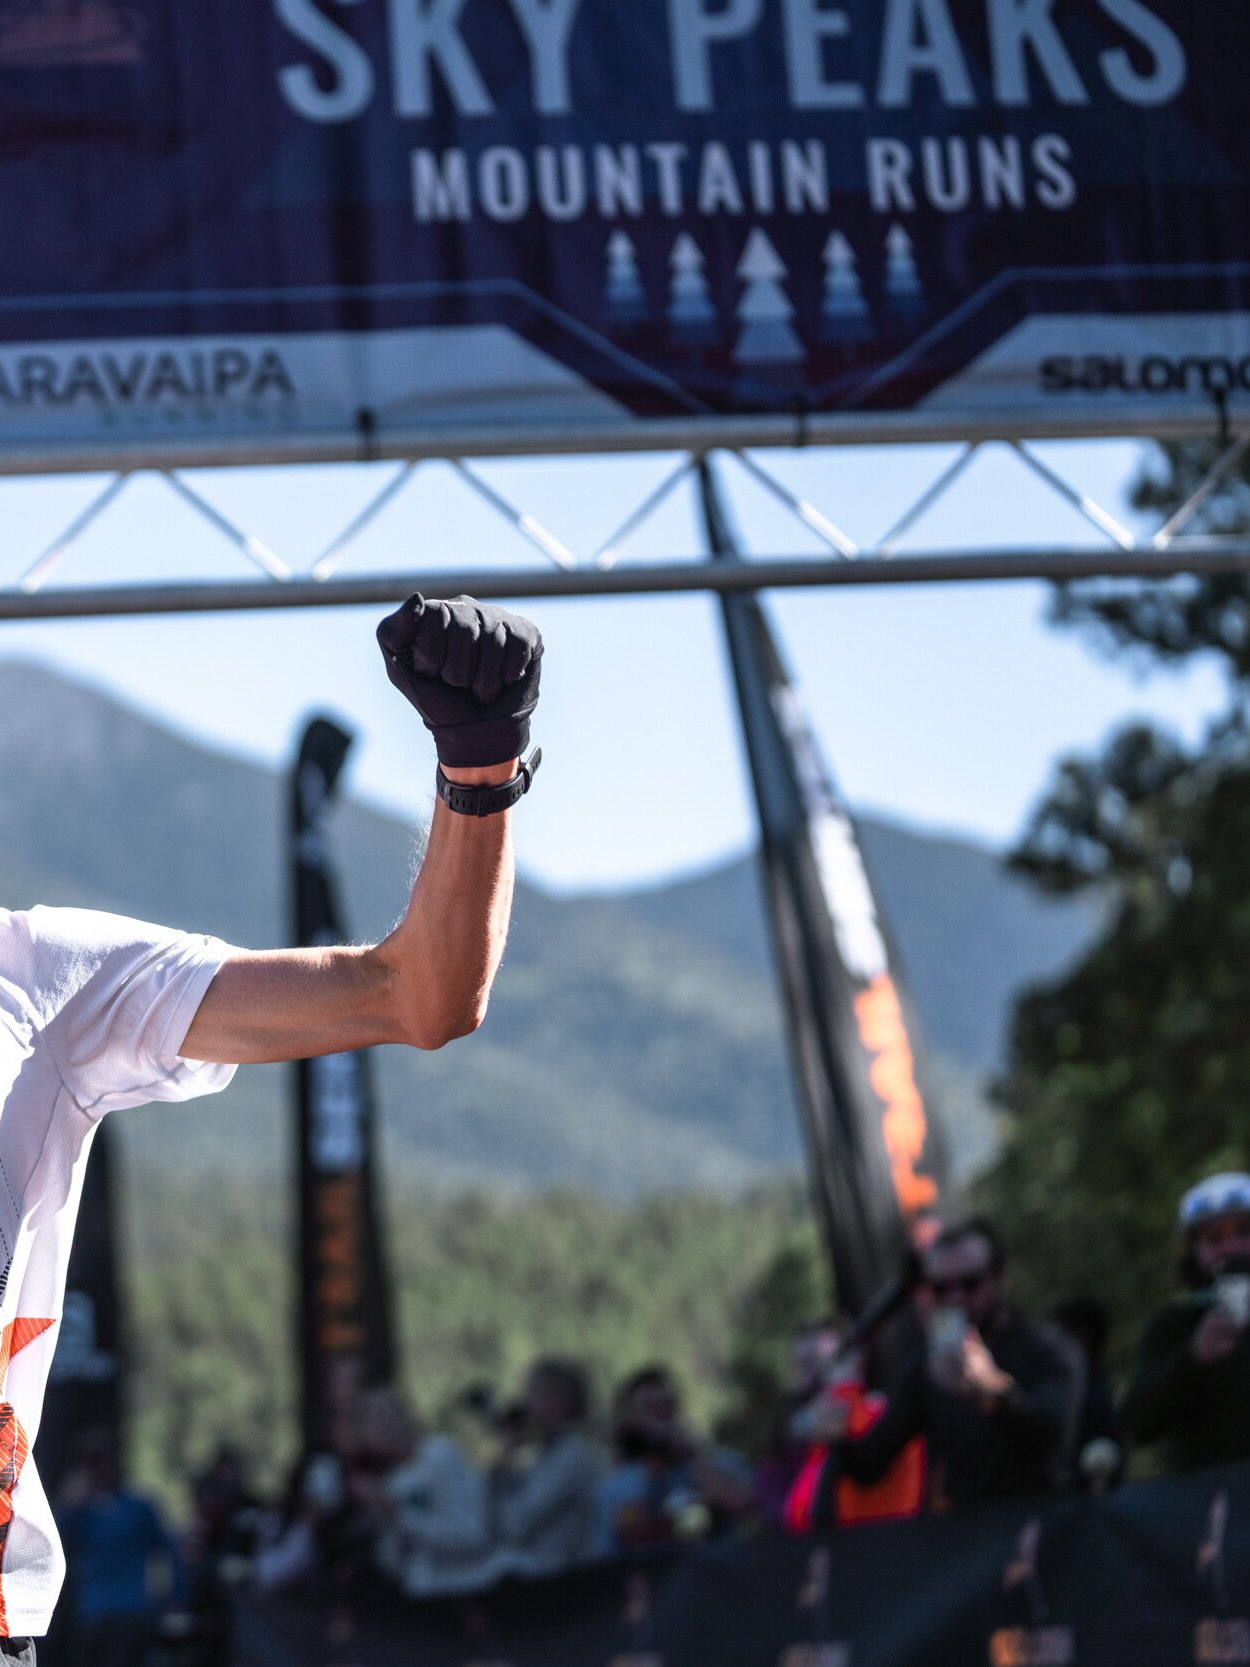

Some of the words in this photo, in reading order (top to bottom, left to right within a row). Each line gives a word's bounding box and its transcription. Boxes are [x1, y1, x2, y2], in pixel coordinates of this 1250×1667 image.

[277, 0, 572, 123] SKY
[670, 0, 1188, 110] PEAKS
[411, 140, 830, 223] MOUNTAIN
[865, 134, 1077, 211] RUNS
